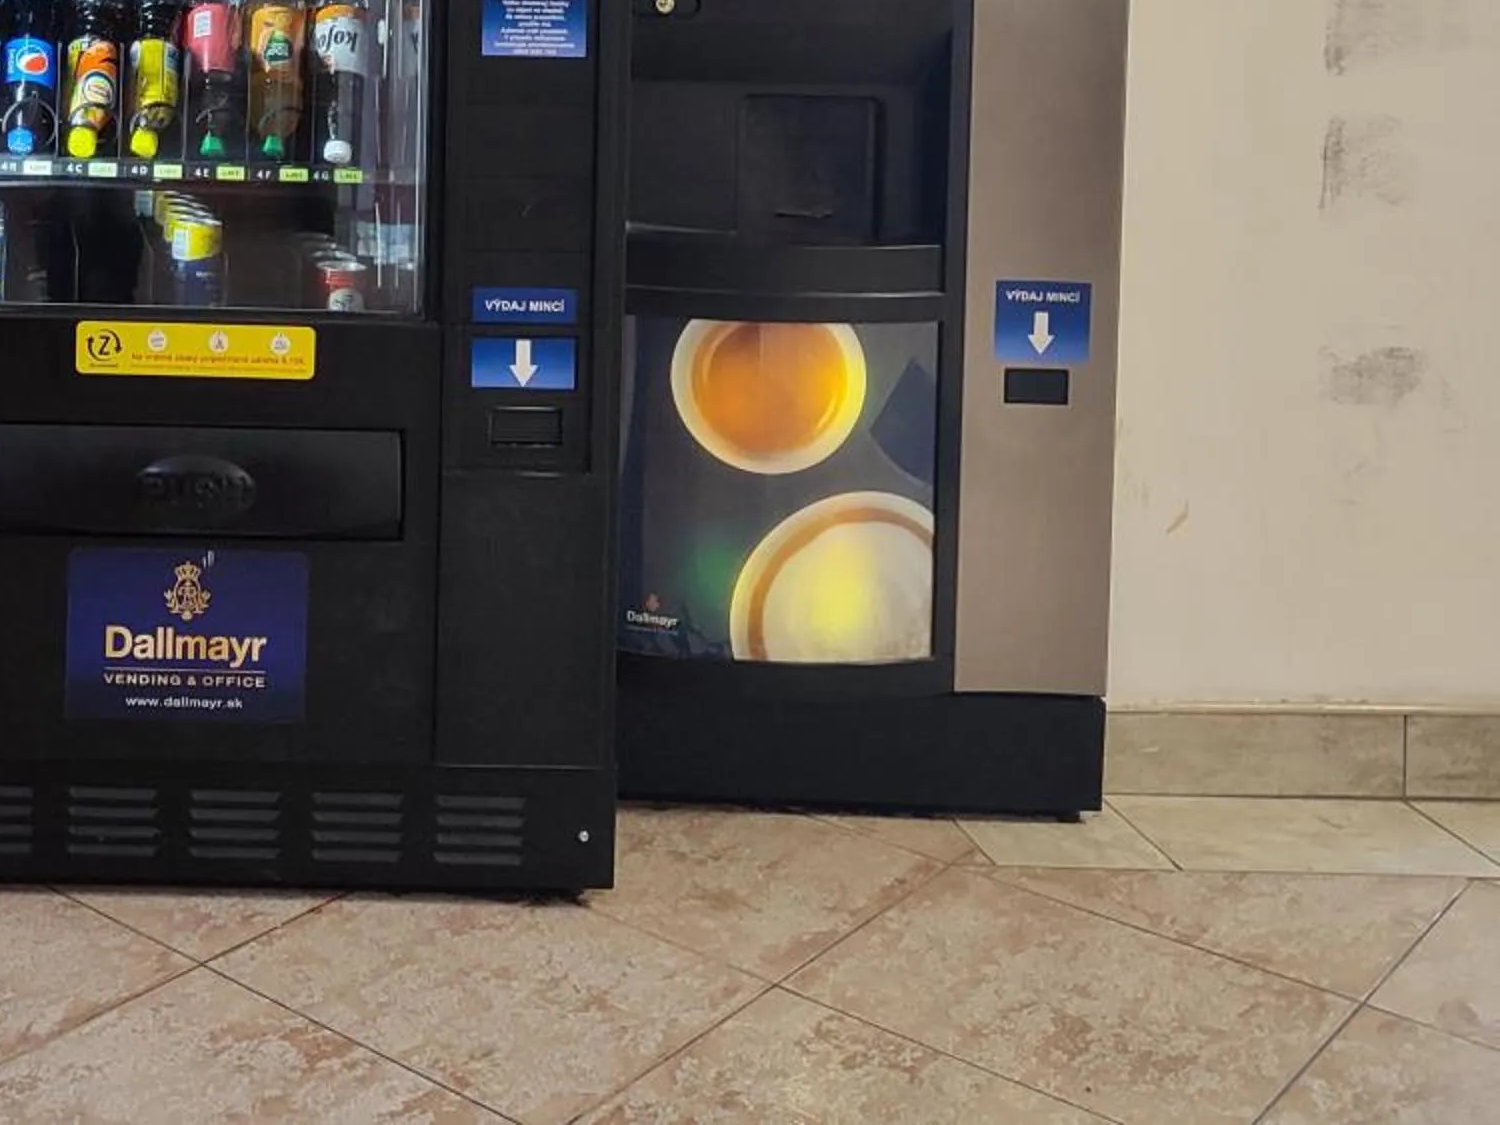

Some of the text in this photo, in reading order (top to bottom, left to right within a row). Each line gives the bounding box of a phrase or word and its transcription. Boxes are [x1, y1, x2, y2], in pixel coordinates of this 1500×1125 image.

[1005, 288, 1081, 303] VÝDAJ MINCÍ
[484, 298, 565, 313] VÝDAJ MINCÍ
[104, 625, 268, 668] Dallmayr
[103, 673, 266, 688] VENDING & OFFICE
[125, 696, 243, 710] www.dallmayr.sk
